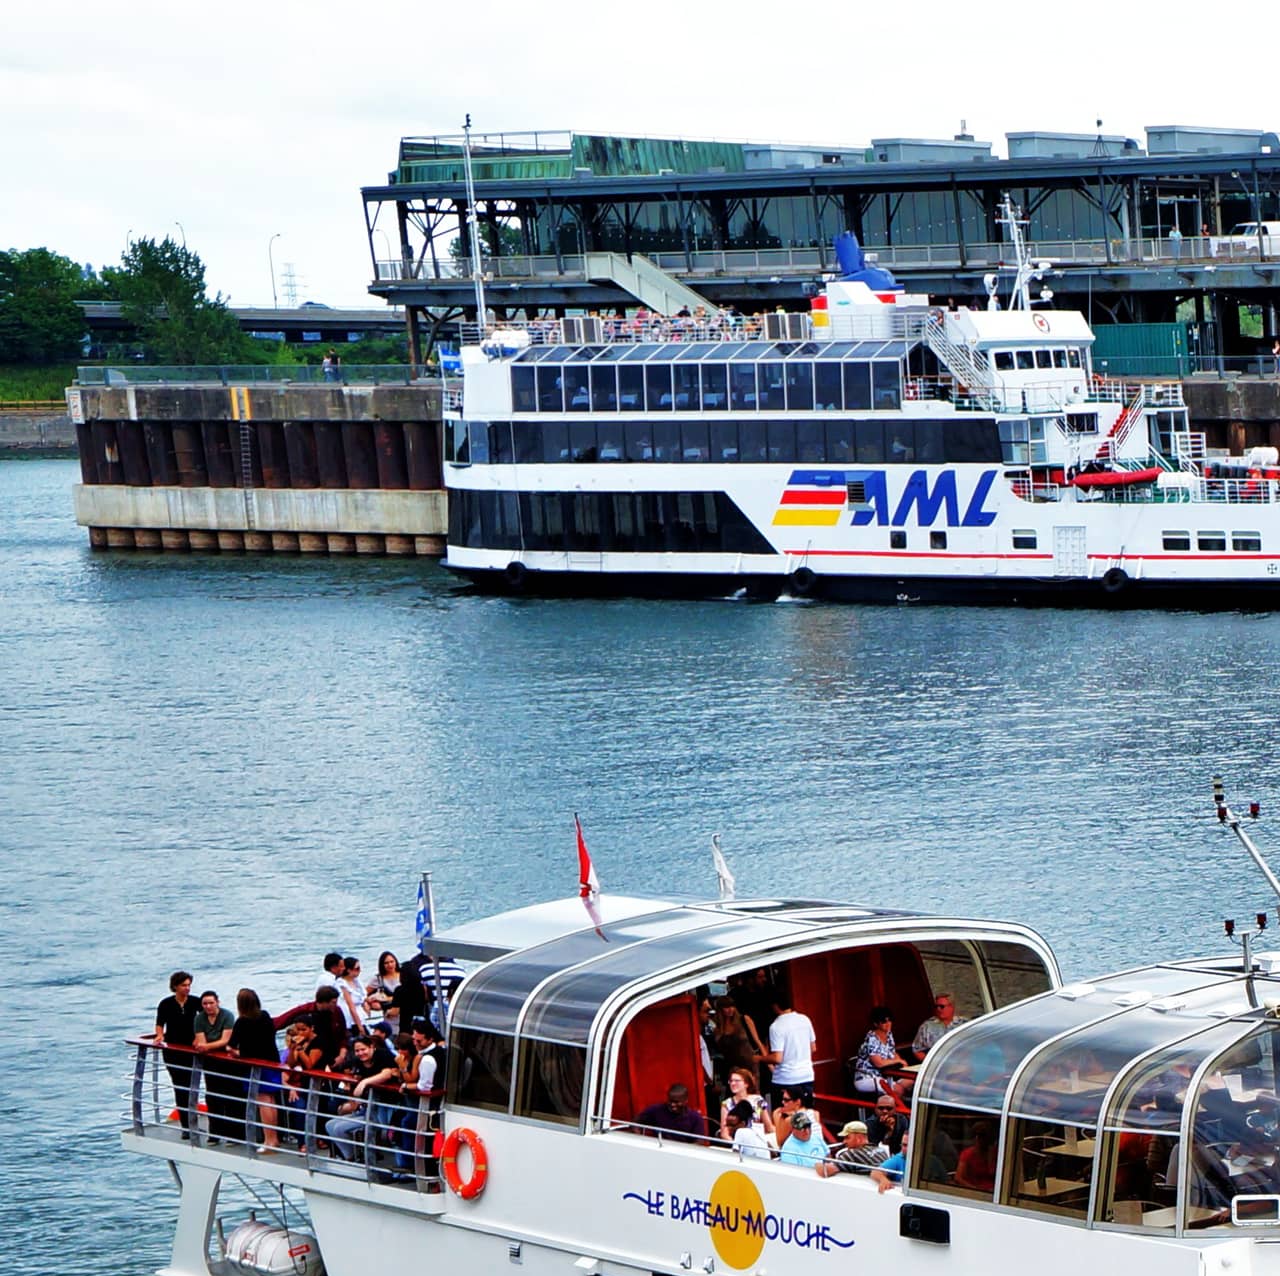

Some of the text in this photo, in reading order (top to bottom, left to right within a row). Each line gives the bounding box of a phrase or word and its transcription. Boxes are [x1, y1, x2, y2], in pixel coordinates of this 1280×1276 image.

[848, 469, 998, 527] AML
[647, 1189, 831, 1252] LE BATEAU MOUCHE
